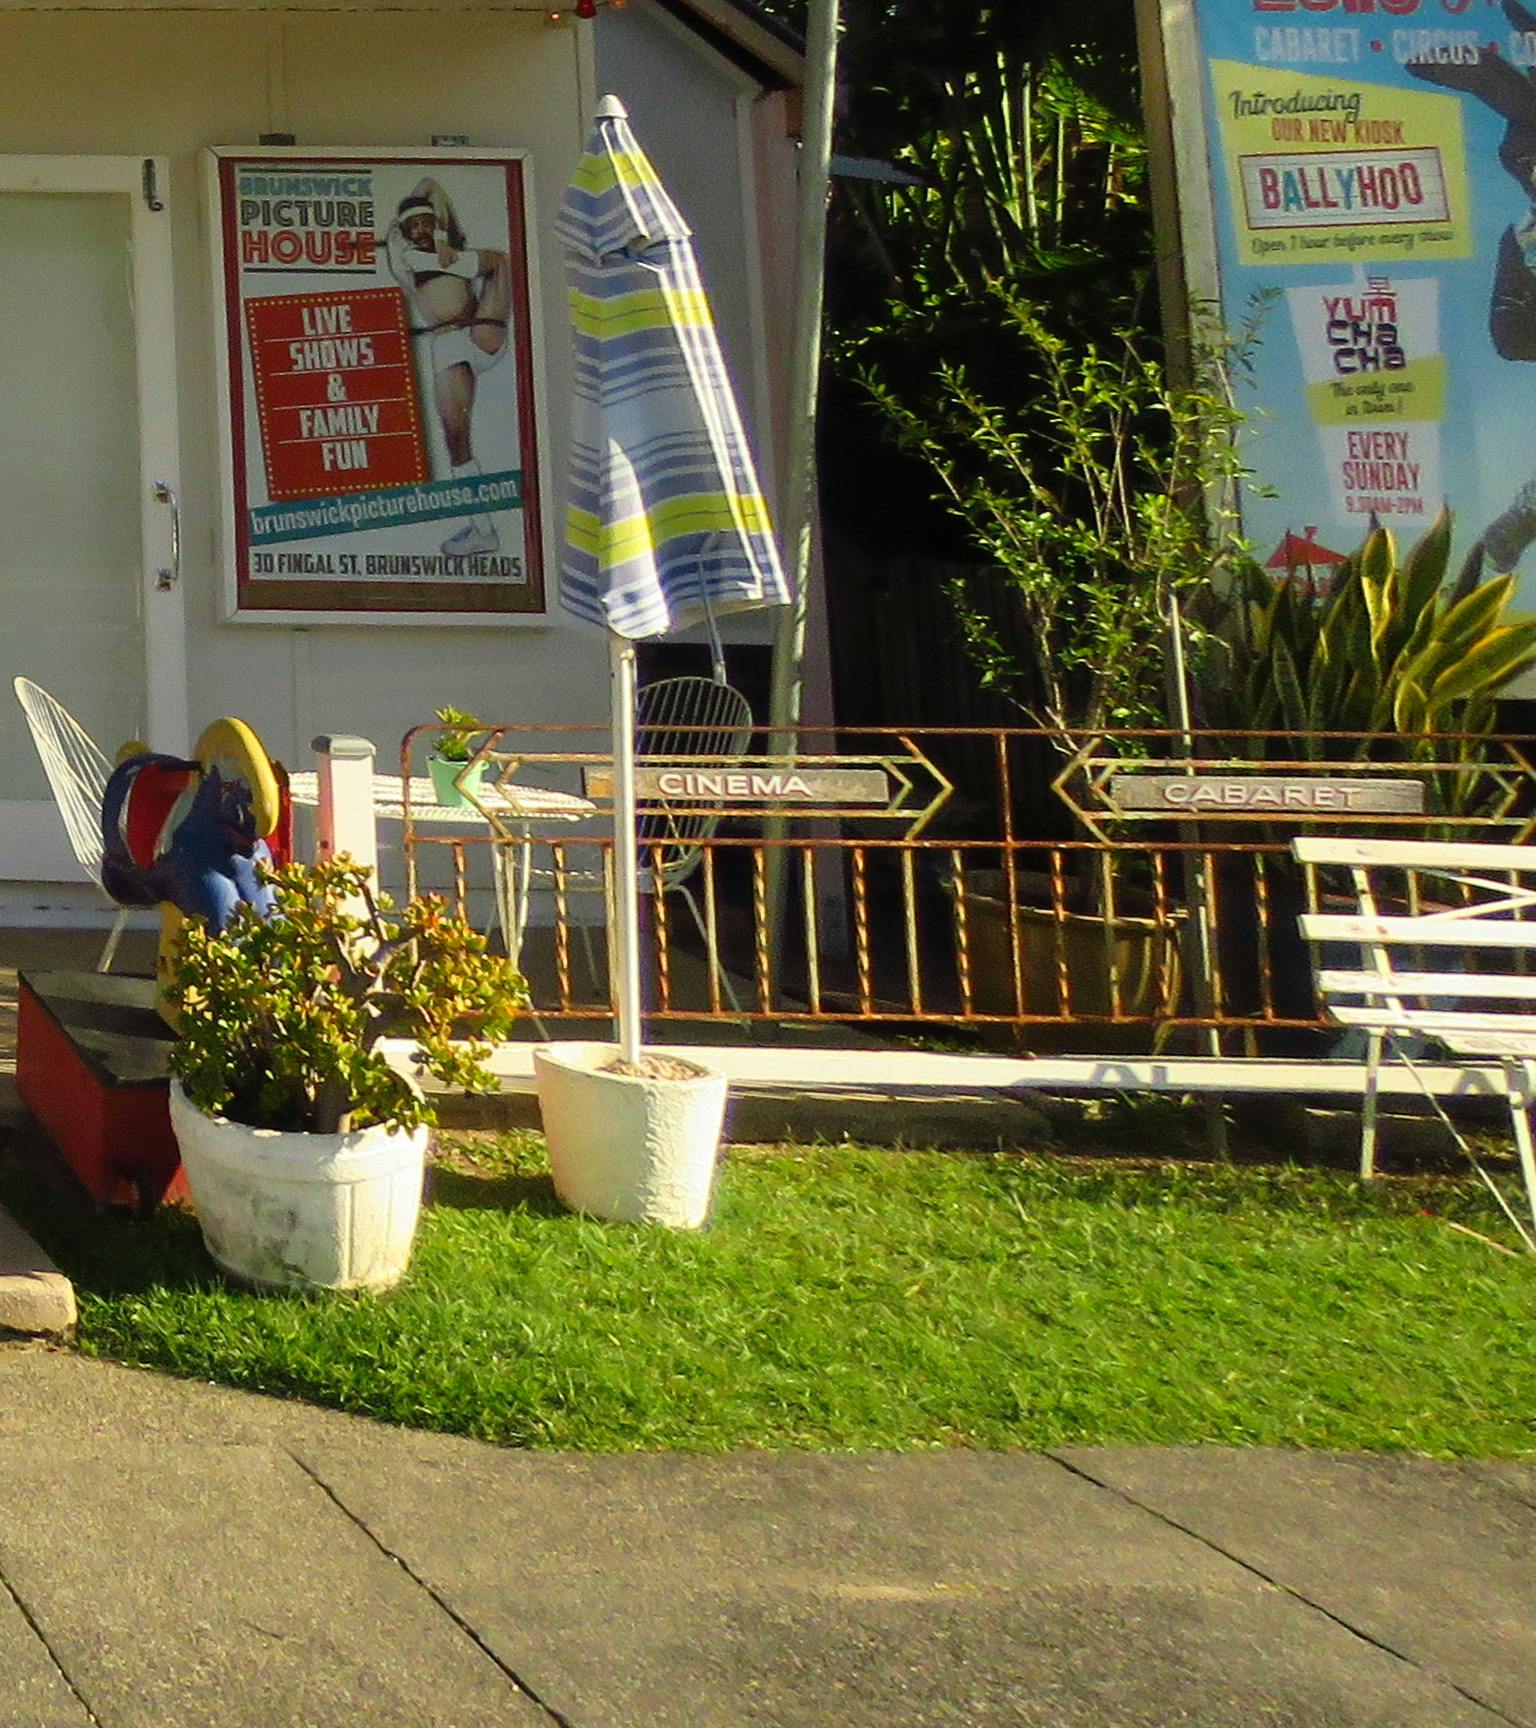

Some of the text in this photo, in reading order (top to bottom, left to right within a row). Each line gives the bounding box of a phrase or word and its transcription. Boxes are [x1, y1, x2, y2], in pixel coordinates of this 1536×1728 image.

[1256, 26, 1360, 62] CABARET
[1392, 29, 1479, 64] CIRCUS
[1228, 89, 1362, 123] Introducing
[1271, 118, 1405, 144] OUR NEW KIOSK
[239, 177, 373, 197] BRUNSWICK
[1259, 162, 1423, 212] BALLYHOO
[240, 200, 374, 227] PICTURE
[241, 230, 376, 265] HOUSE
[301, 304, 352, 336] LIVE
[289, 337, 375, 371] SHOWS
[327, 373, 348, 402] &
[299, 405, 379, 439] FAMILY
[321, 440, 368, 472] FUN
[1347, 431, 1408, 460] EVERY
[1343, 461, 1420, 490] SUNDAY
[251, 479, 517, 536] brunswickpicturehouse.com
[253, 553, 522, 577] 30 FINGAL ST. BRUNSWICK HEADS
[658, 773, 812, 798] CINEMA
[1164, 784, 1361, 808] CABARET
